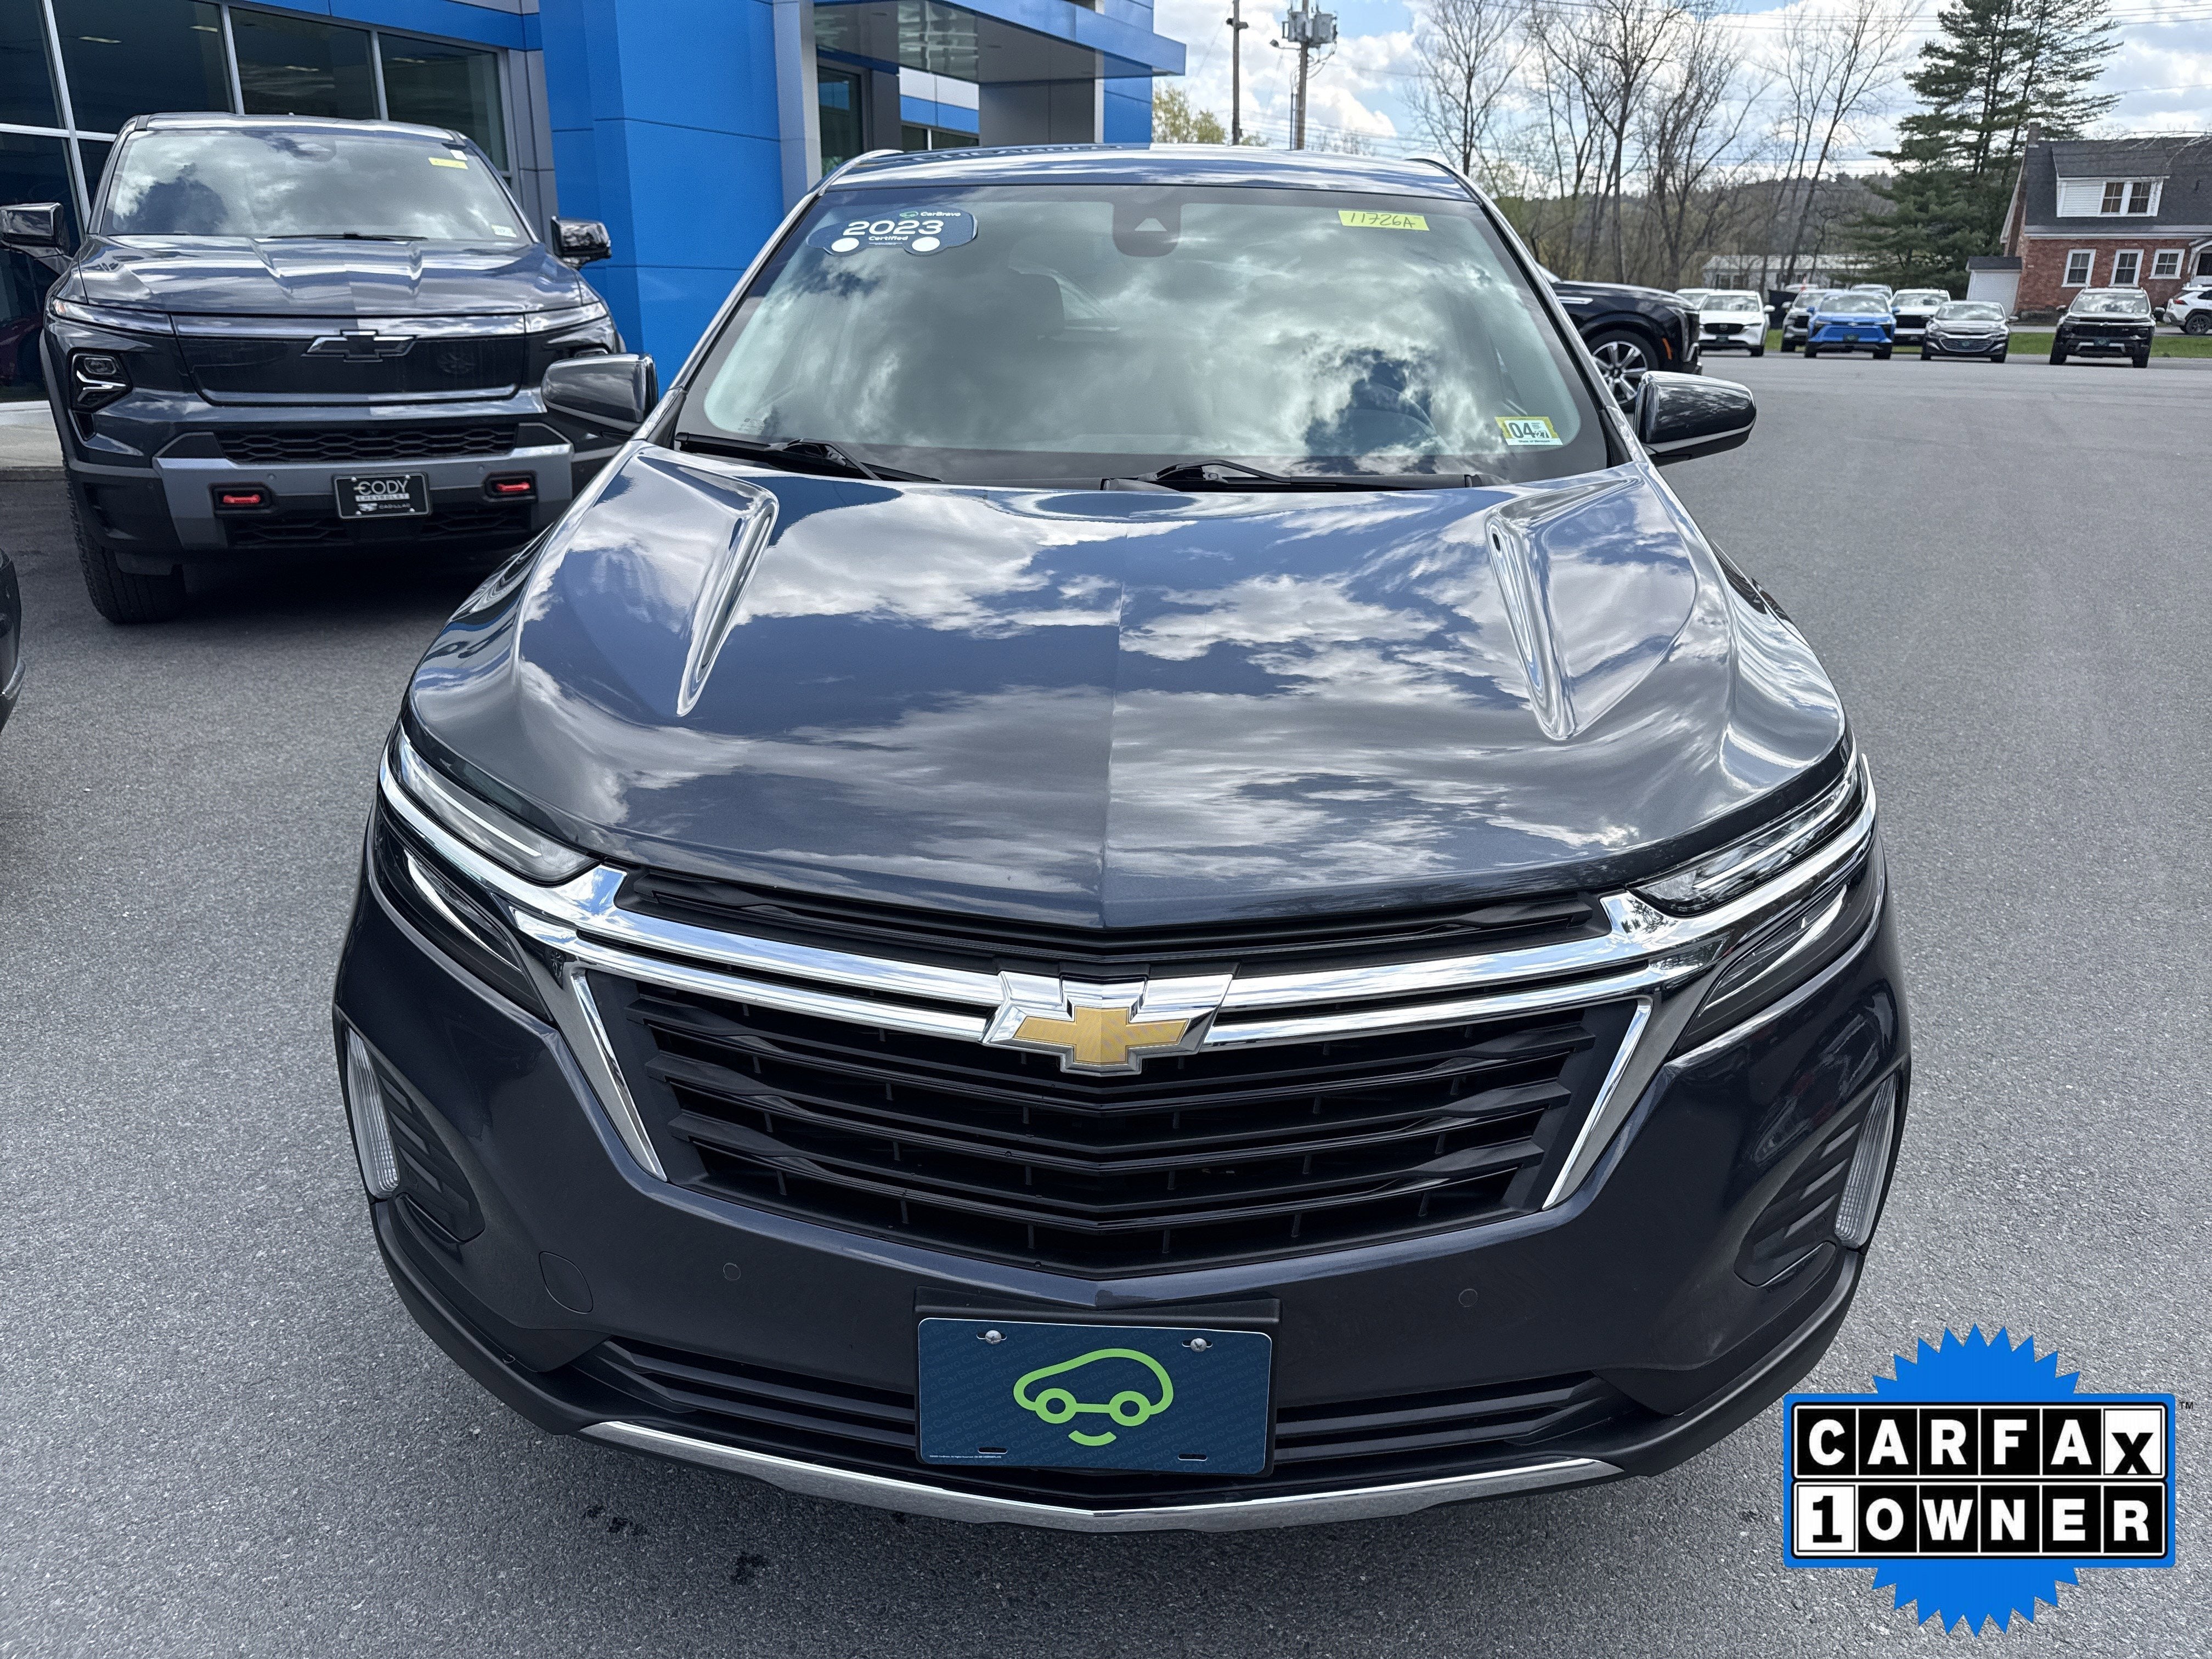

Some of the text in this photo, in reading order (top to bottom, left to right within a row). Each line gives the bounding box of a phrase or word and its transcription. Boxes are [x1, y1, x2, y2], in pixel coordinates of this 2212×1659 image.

[843, 220, 944, 236] 2023
[1351, 212, 1415, 228] 11726A
[1508, 422, 1536, 438] 04
[356, 480, 409, 495] CODY
[925, 1339, 978, 1365] CarBravo
[938, 1361, 991, 1386] CarBravo
[991, 1340, 1045, 1366] CarBravo
[961, 1339, 1014, 1364] CarBravo
[921, 1339, 1081, 1406] CarBravo CarBravo CarBravo
[950, 1382, 1003, 1408] CarBravo
[963, 1403, 1015, 1429] CarBravo
[1070, 1362, 1124, 1388] CarBravo
[933, 1401, 986, 1427] CarBravo
[1023, 1384, 1238, 1466] CarBravo CarBravo
[1052, 1444, 1105, 1467] CarBravo
[1159, 1406, 1214, 1431] CarBravo
[1214, 1385, 1268, 1411] CarBravo
[946, 1423, 998, 1448] CarBravo
[975, 1424, 1028, 1449] CarBravo
[1011, 1423, 1064, 1448] CarBravo
[1088, 1405, 1250, 1468] CarBravo CarBravo CarBravo
[1118, 1446, 1171, 1469] CarBravo
[1171, 1427, 1225, 1452] CarBravo
[1207, 1426, 1261, 1452] CarBravo
[1183, 1447, 1237, 1470] CarBravo
